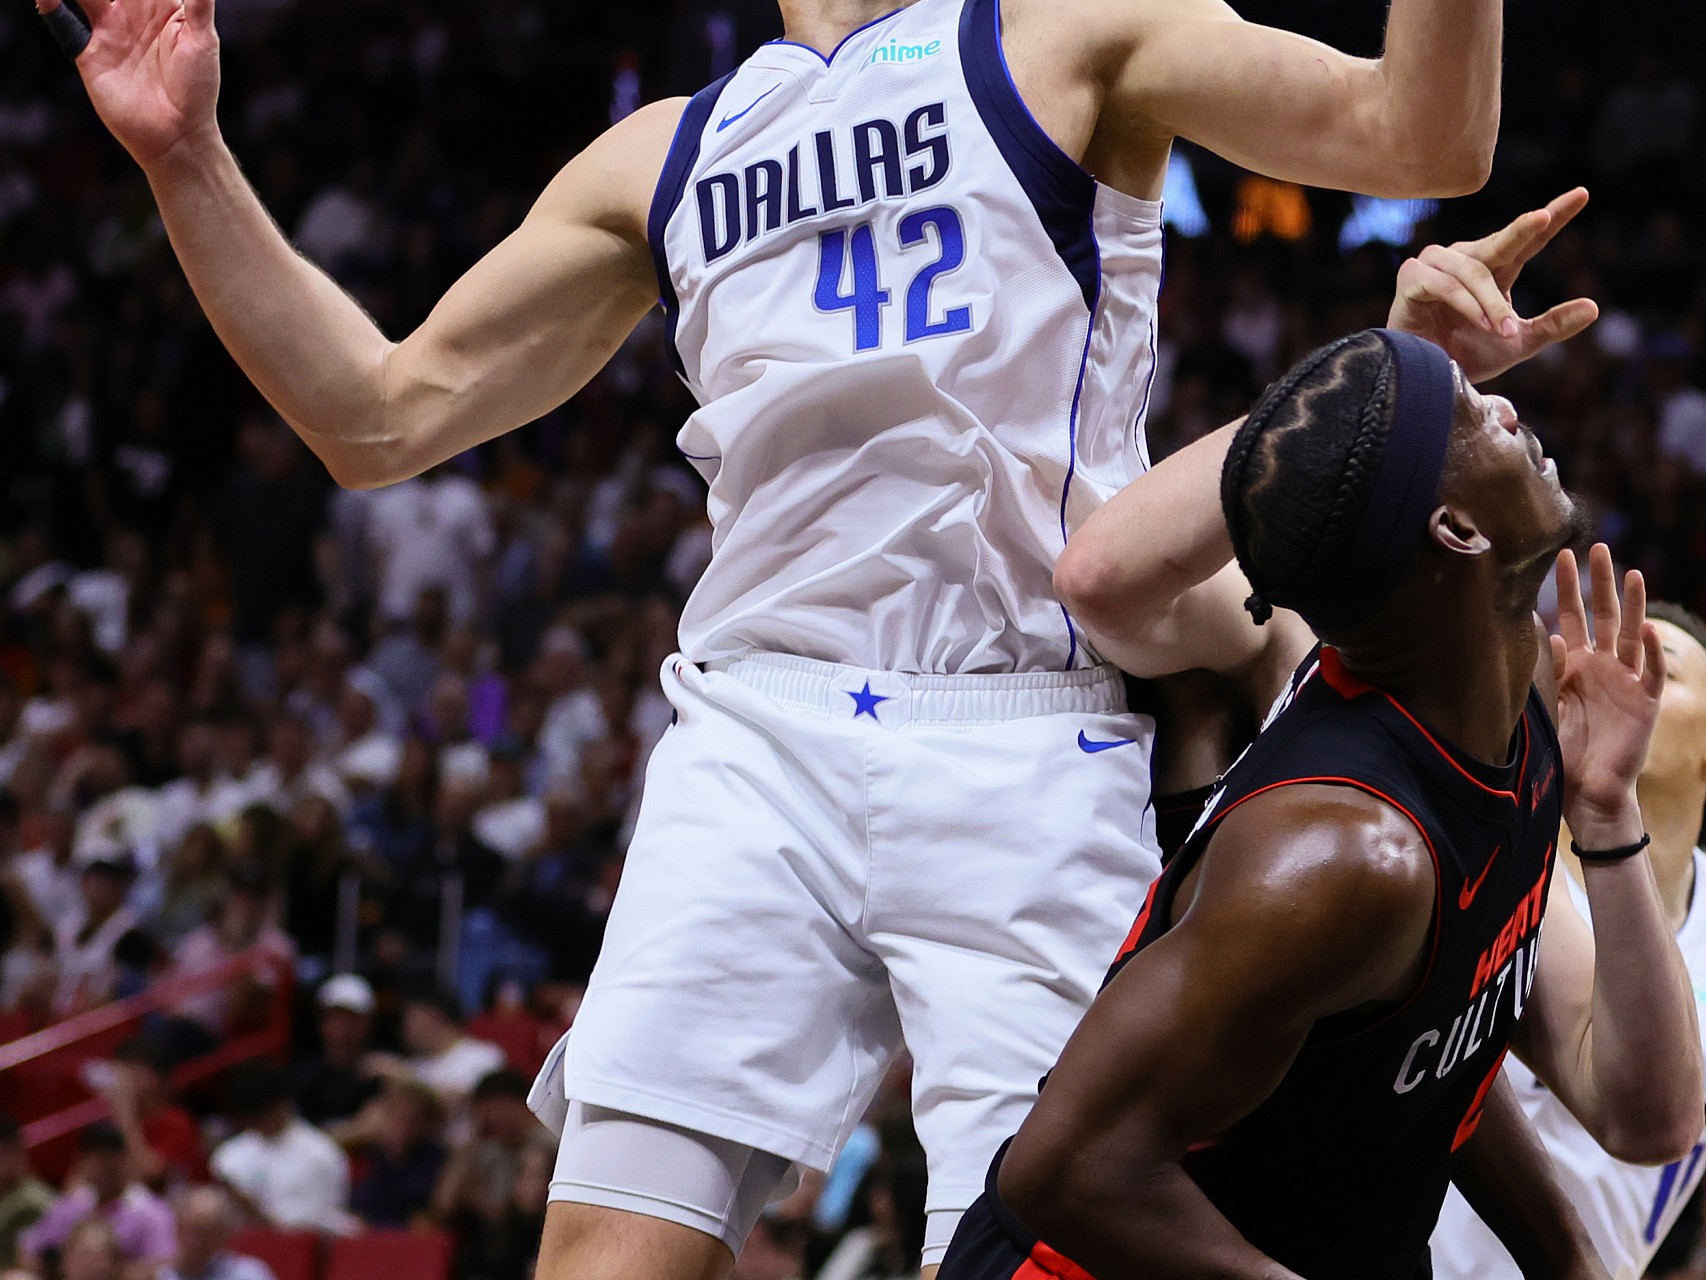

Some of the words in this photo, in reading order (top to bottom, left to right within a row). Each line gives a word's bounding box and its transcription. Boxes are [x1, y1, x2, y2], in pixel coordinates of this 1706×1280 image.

[695, 102, 950, 267] DALLAS
[811, 204, 975, 354] 42
[1469, 840, 1552, 1001] HEAT
[1392, 917, 1545, 1094] CULTU
